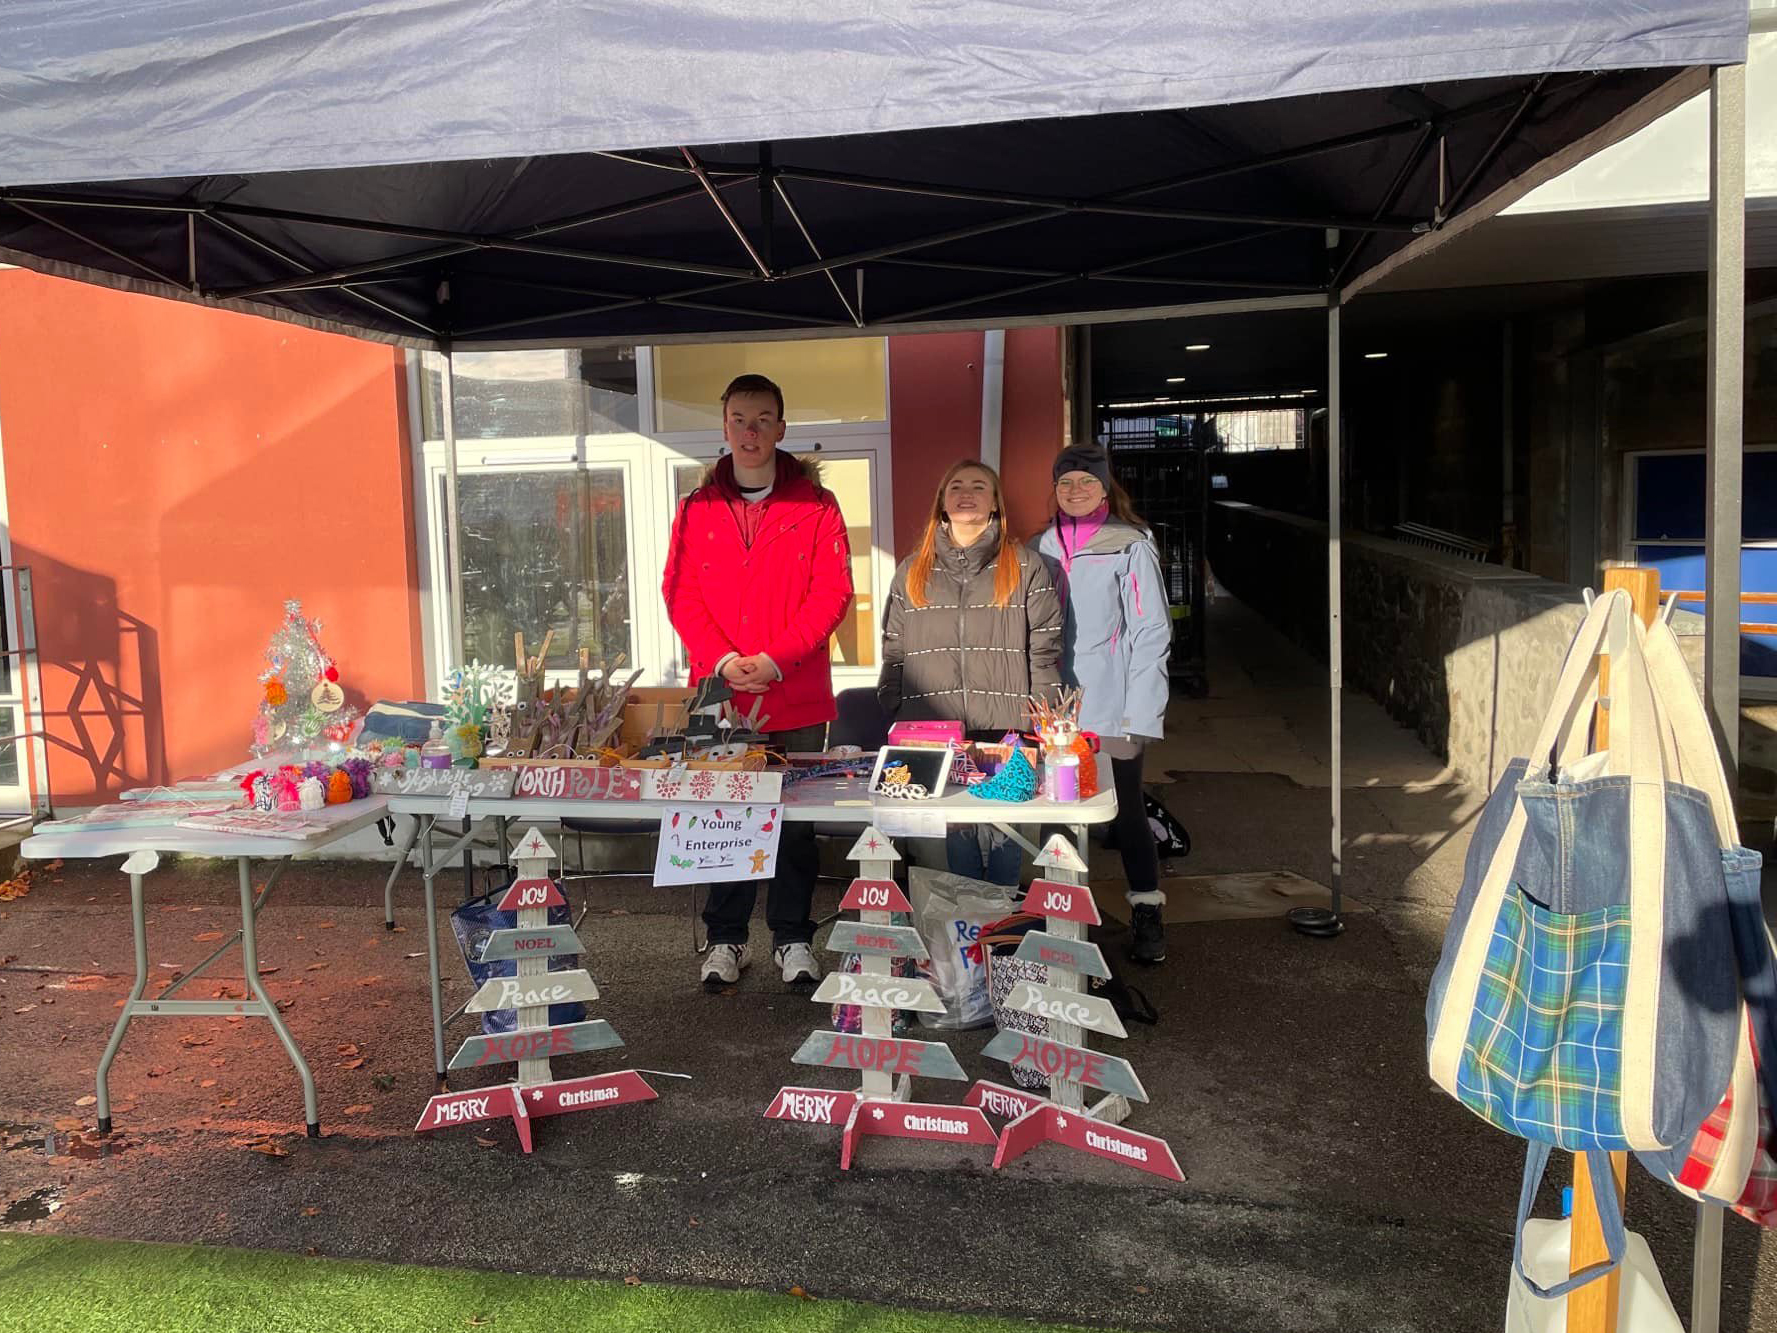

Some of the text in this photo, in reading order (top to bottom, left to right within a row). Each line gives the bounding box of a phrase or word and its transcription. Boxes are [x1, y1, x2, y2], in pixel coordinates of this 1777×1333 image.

[701, 819, 742, 831] Young
[685, 838, 752, 851] Enterprise
[517, 886, 548, 906] JOY
[858, 887, 890, 907] JOY
[1043, 891, 1072, 913] JOY
[514, 937, 557, 951] NOEL
[497, 980, 573, 1009] Peace
[836, 975, 922, 1008] Peace
[1021, 984, 1101, 1025] Peace
[473, 1026, 577, 1067] HOPE
[823, 1035, 928, 1075] HOPE
[1011, 1035, 1108, 1086] HOPE
[433, 1096, 490, 1125] MERRY
[776, 1092, 969, 1135] MERRY Christmas
[980, 1089, 1148, 1162] MERRY Christmas
